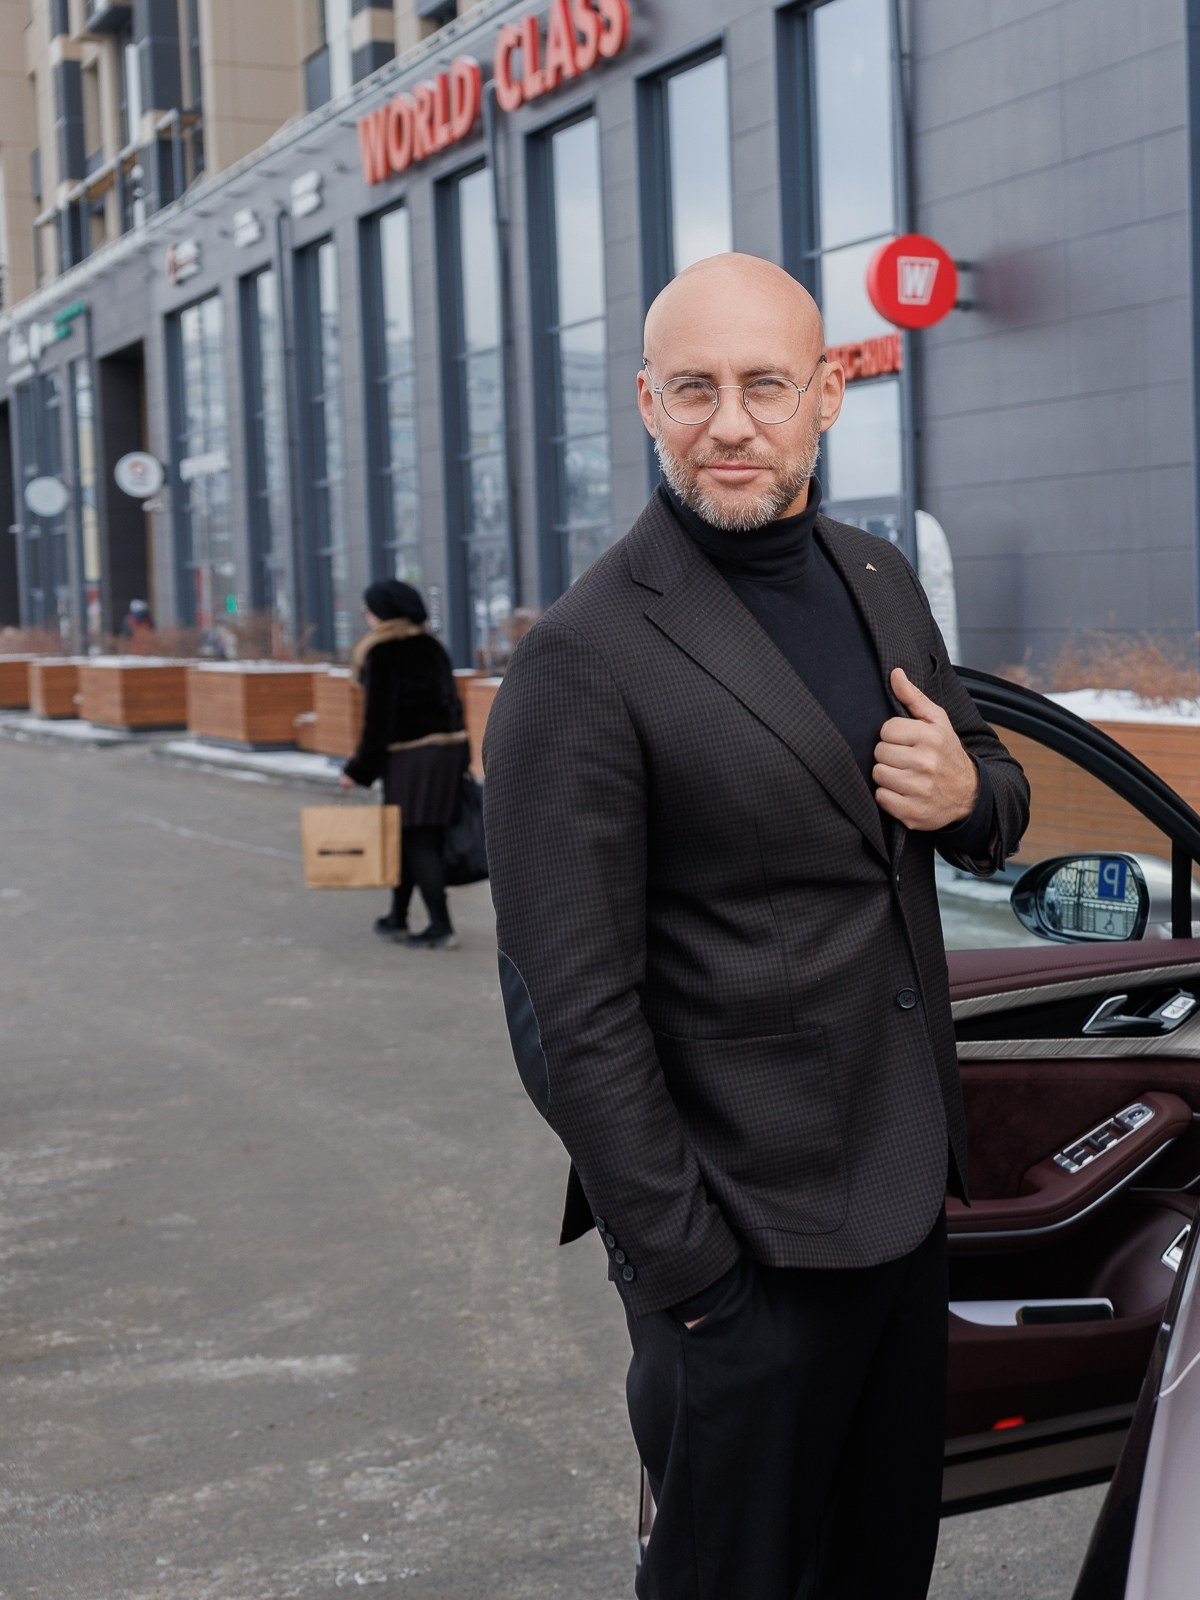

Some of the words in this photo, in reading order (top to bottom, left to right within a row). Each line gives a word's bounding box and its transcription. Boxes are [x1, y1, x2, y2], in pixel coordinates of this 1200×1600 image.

[357, 54, 483, 186] WORLD
[493, 0, 632, 112] CLASS
[899, 258, 937, 302] W
